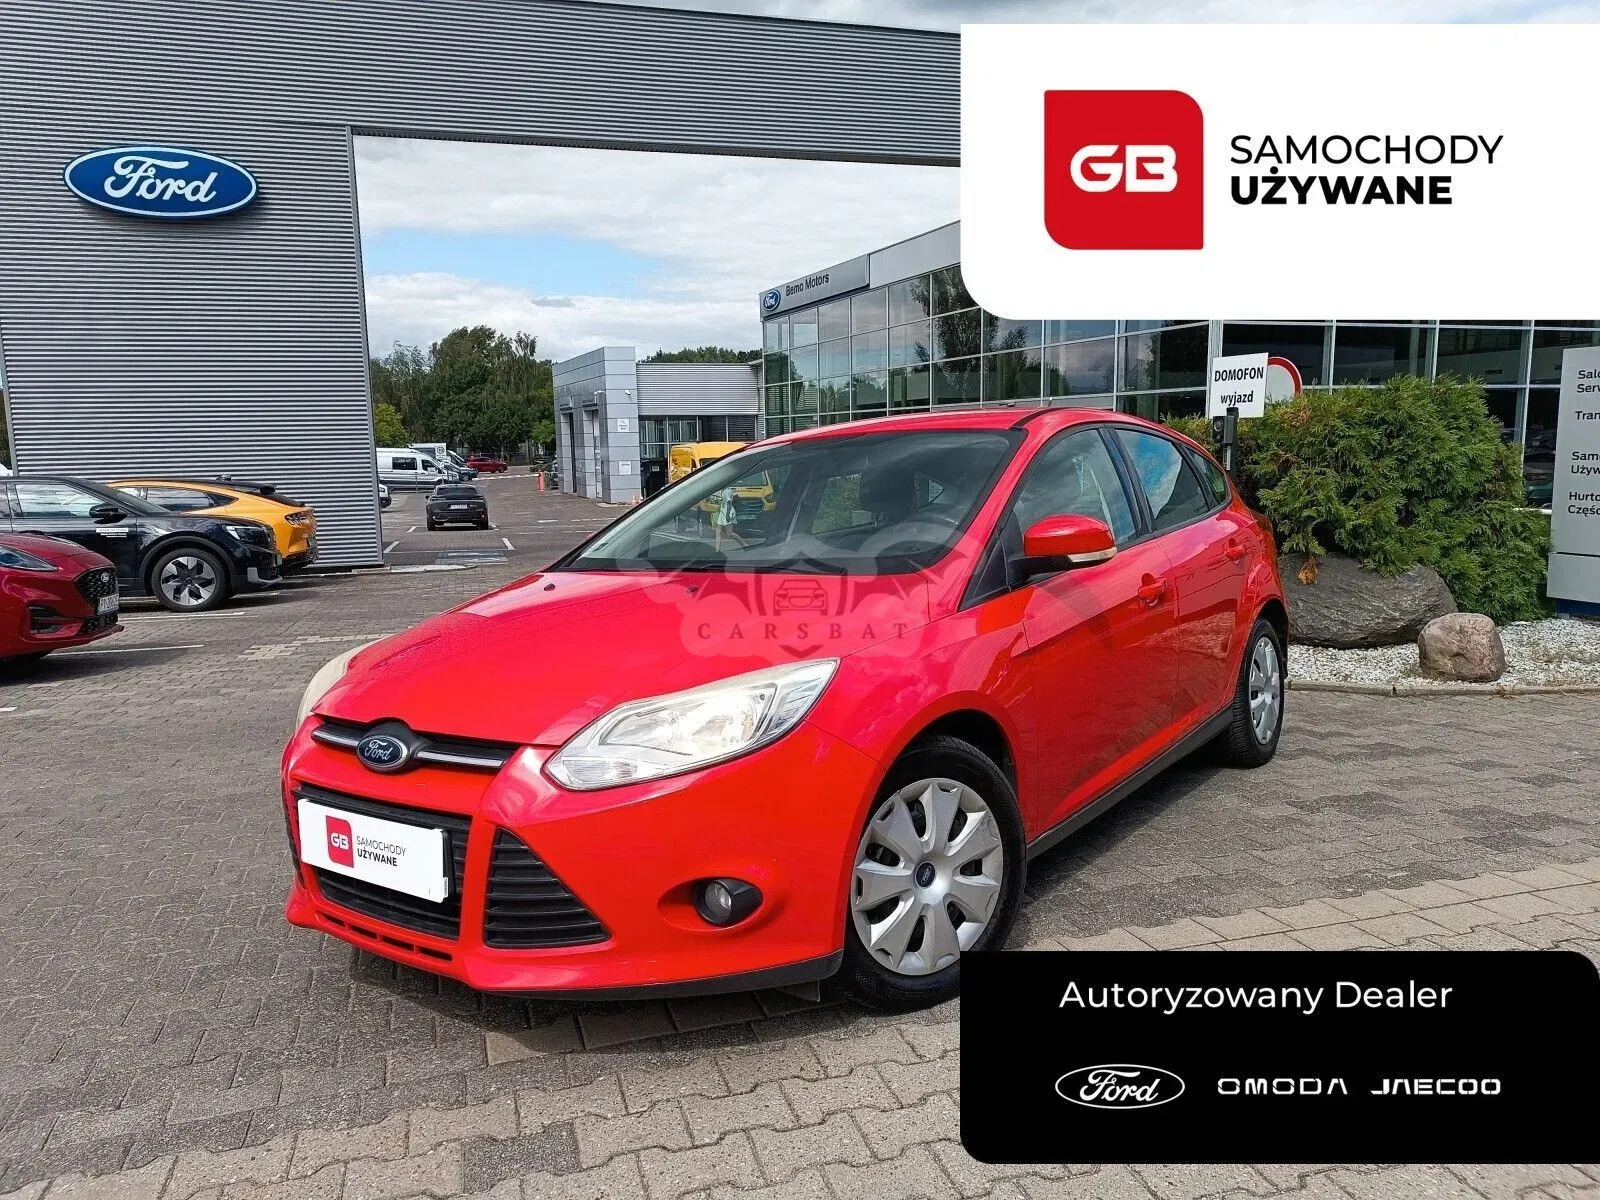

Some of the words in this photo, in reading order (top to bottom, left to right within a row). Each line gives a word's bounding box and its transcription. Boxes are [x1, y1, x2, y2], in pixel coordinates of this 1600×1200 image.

[104, 155, 218, 203] Ford
[786, 282, 804, 296] Bemo
[805, 274, 829, 290] Motors
[1214, 366, 1264, 382] DOMOFON
[1220, 390, 1254, 407] wyjazd
[1571, 451, 1600, 461] Sam
[363, 738, 393, 761] Ford
[356, 835, 407, 857] SAMOCHODY
[357, 846, 398, 867] UŻYWANE
